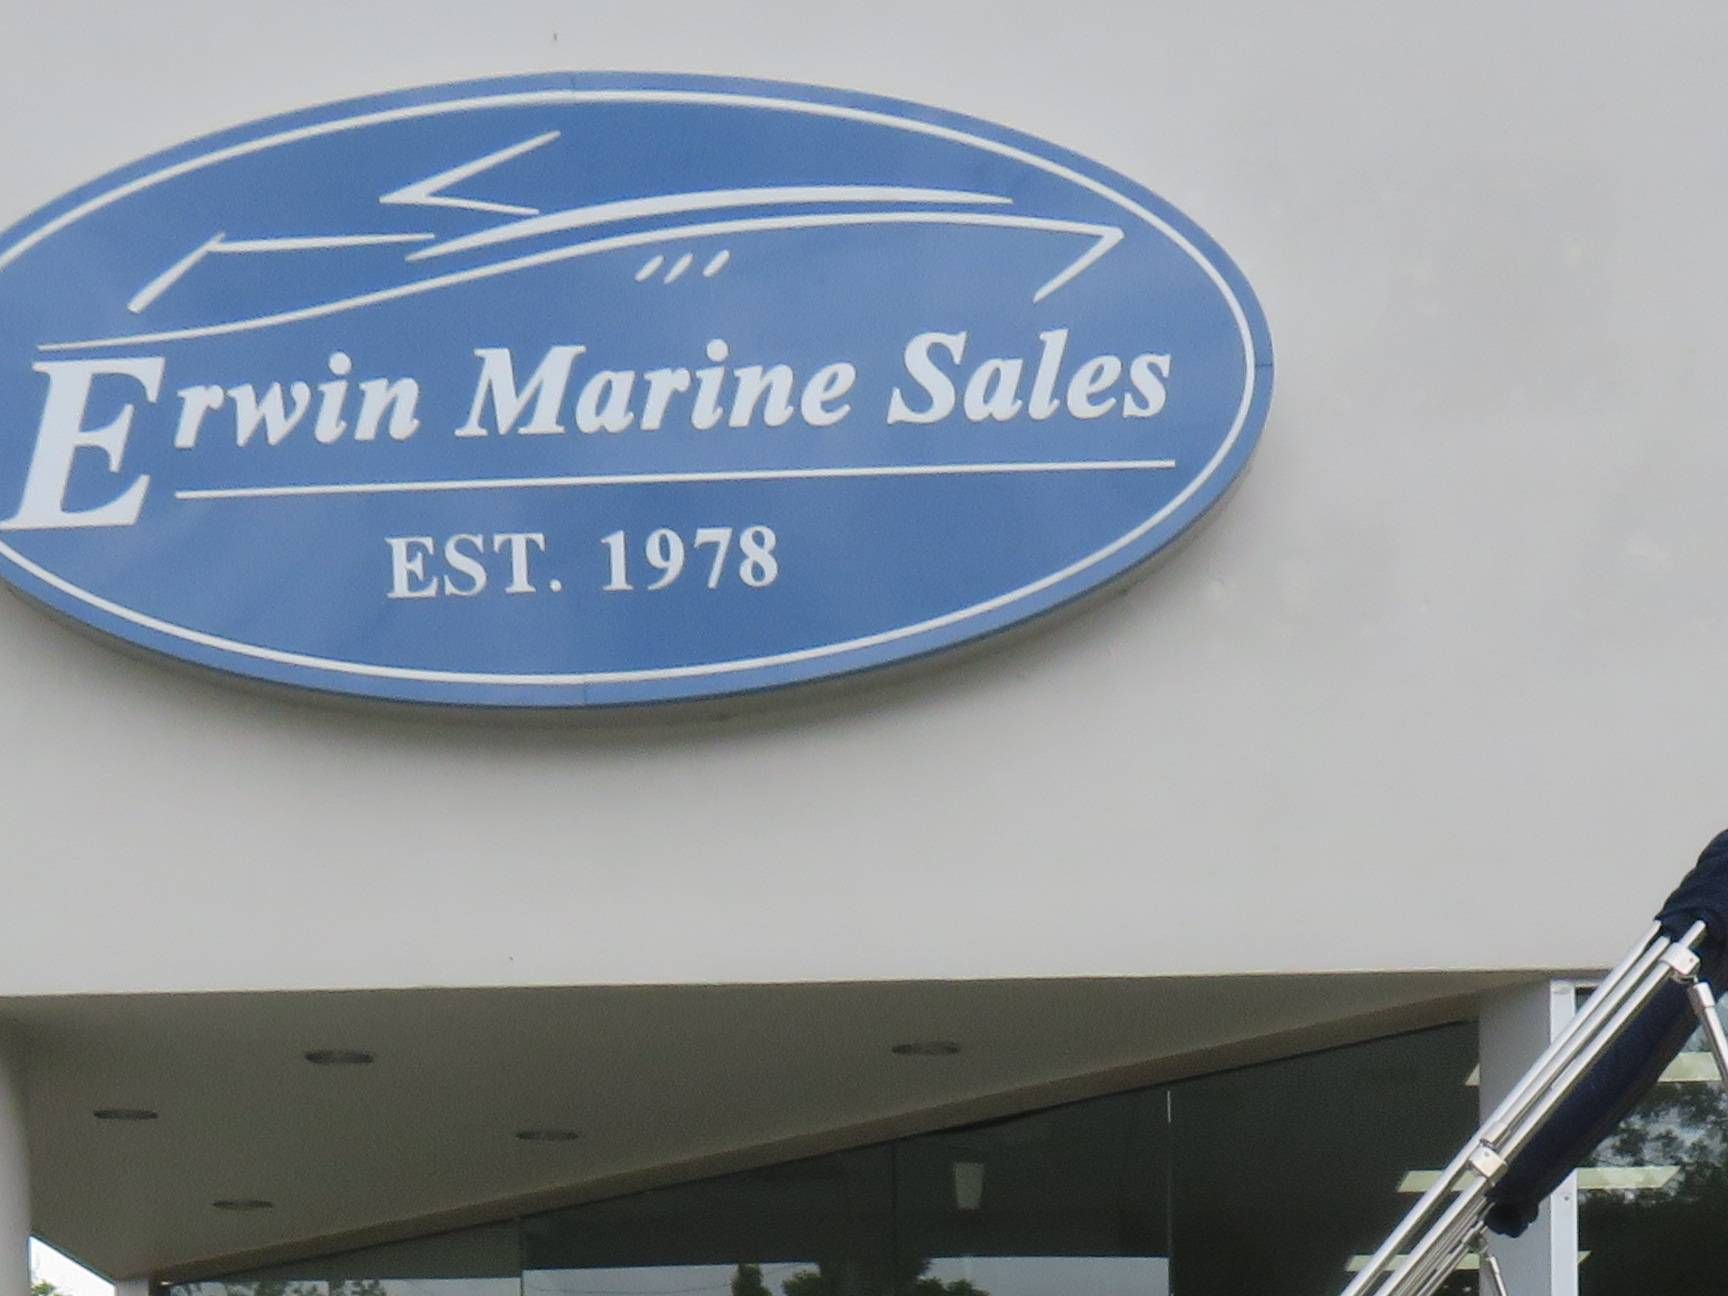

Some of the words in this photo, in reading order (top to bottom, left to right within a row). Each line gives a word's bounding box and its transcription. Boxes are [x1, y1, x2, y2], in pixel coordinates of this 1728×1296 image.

[454, 338, 857, 437] Marine
[886, 328, 1171, 425] Sales
[385, 532, 562, 599] EST.
[601, 525, 778, 591] 1978
